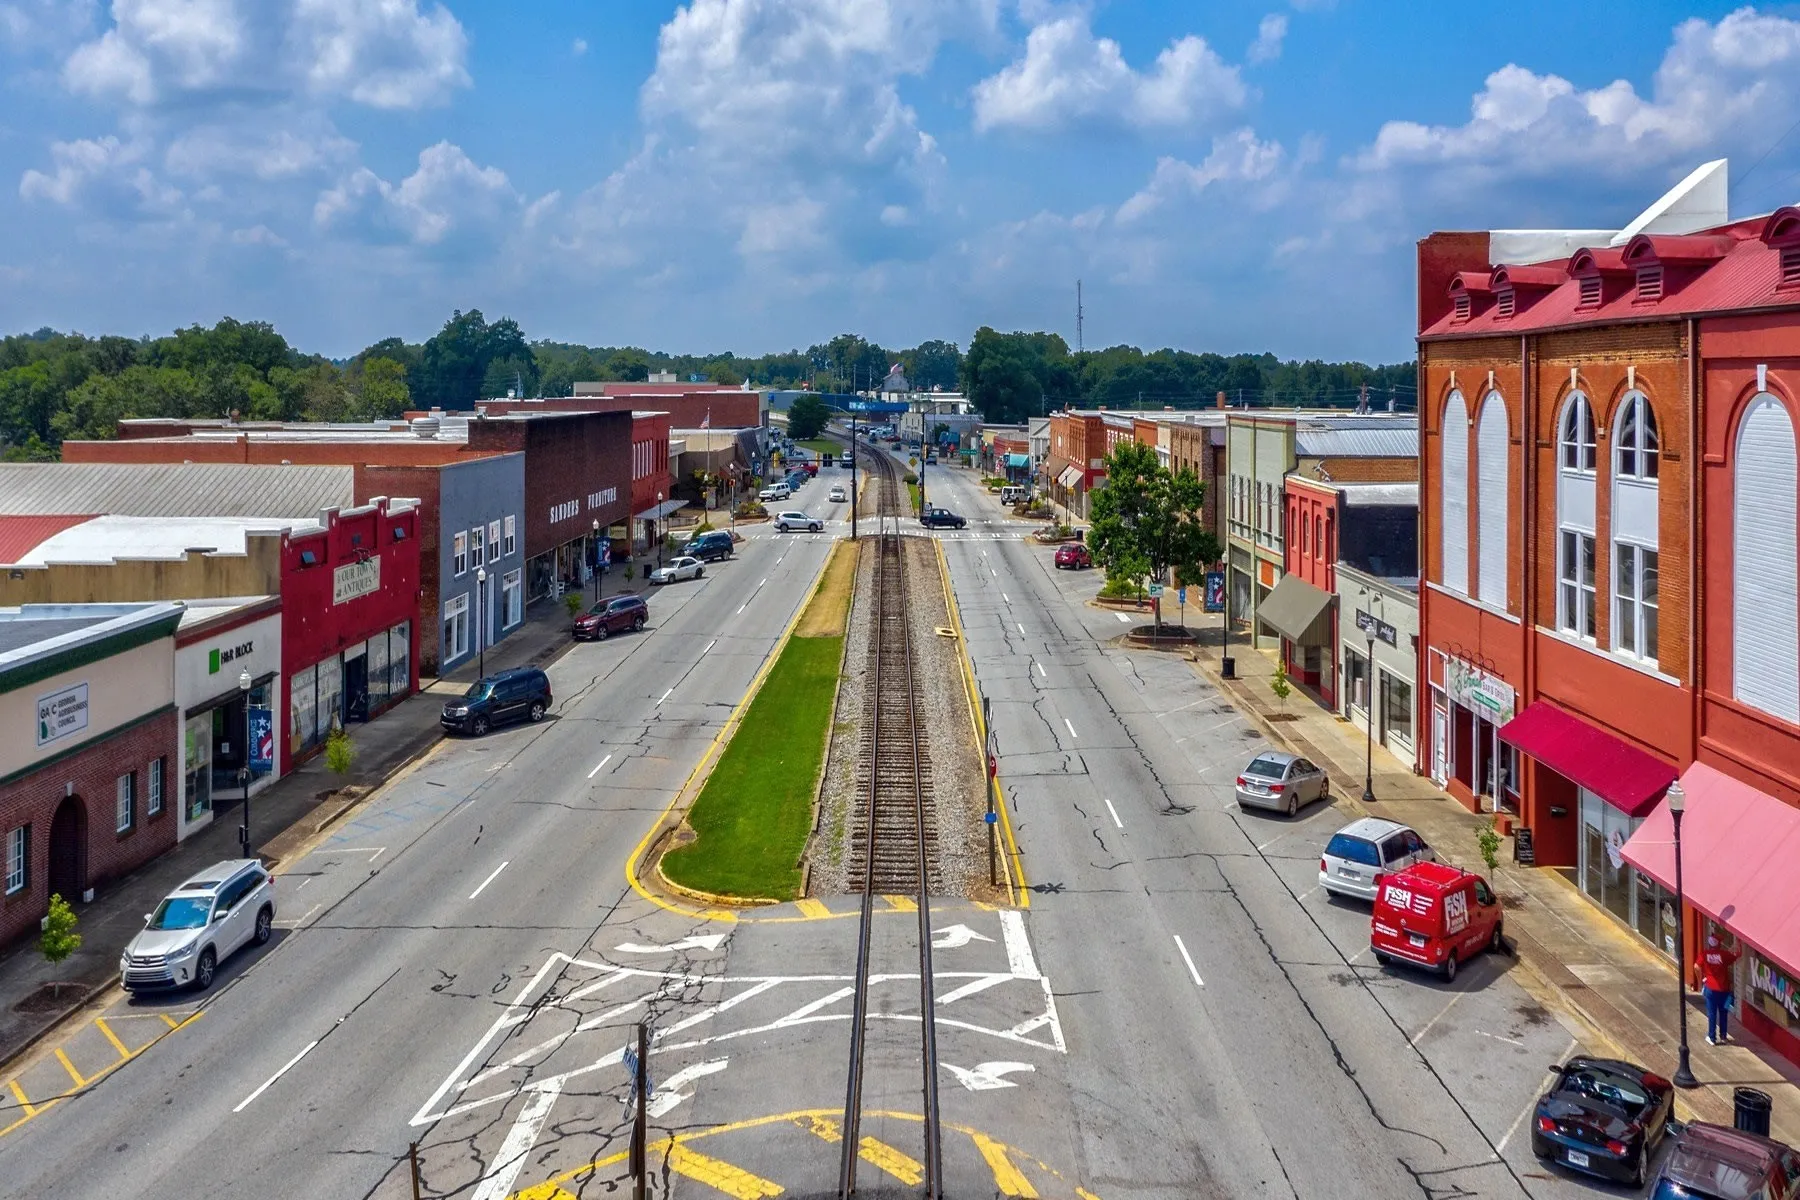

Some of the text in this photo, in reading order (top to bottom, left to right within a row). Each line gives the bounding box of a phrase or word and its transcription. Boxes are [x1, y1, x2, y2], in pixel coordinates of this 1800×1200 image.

[550, 487, 616, 523] SANDERS FURNITURE
[341, 566, 355, 582] OUR
[342, 576, 373, 596] ANTIQUES
[1150, 586, 1157, 596] P
[220, 640, 254, 666] H&R BLOCK
